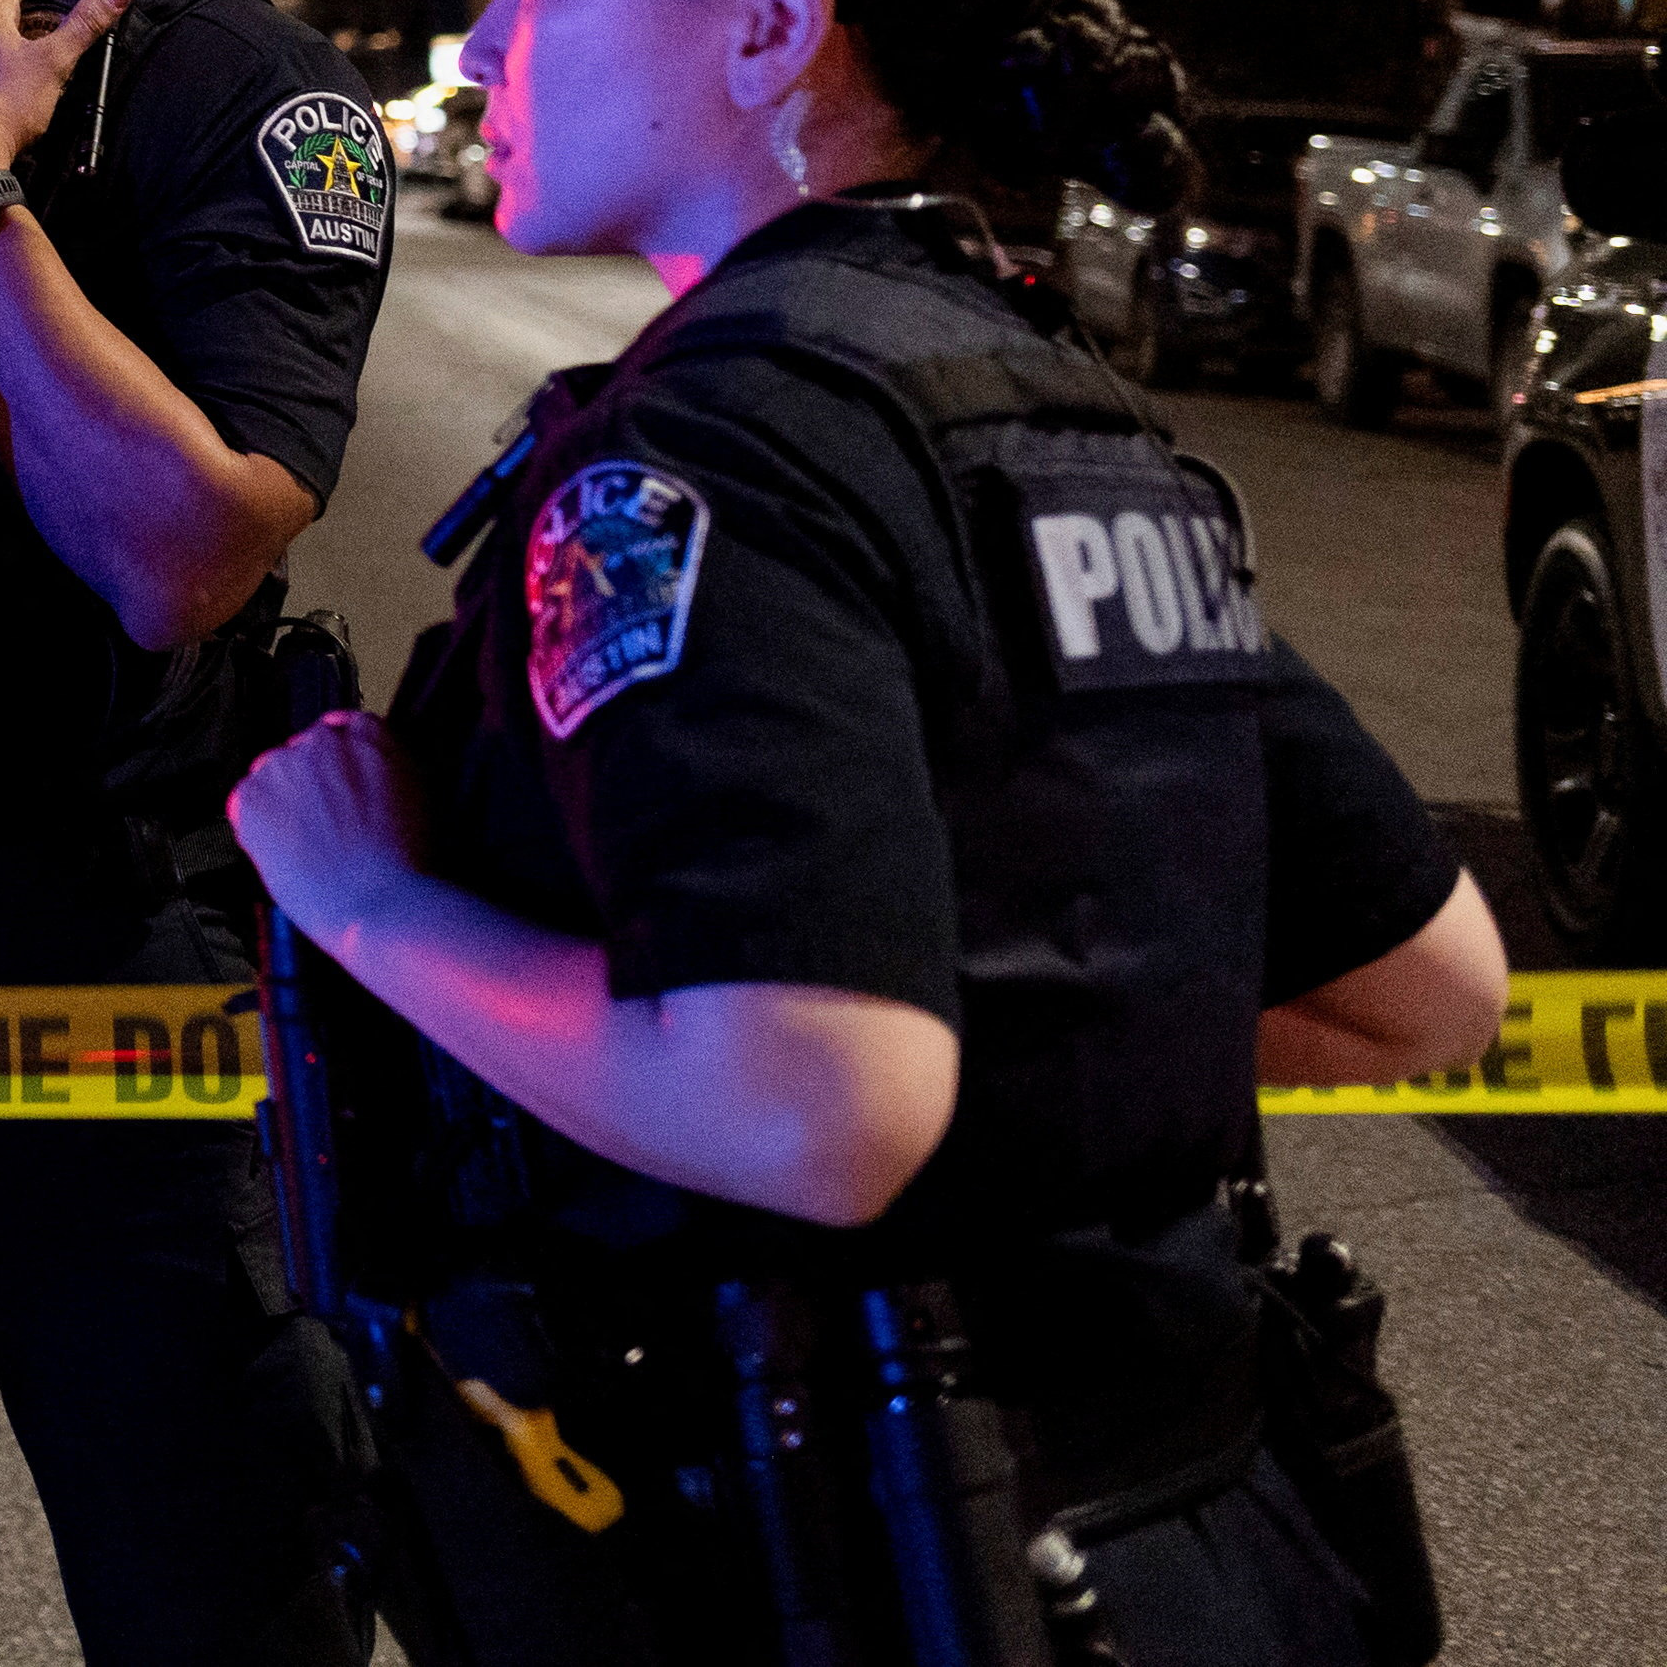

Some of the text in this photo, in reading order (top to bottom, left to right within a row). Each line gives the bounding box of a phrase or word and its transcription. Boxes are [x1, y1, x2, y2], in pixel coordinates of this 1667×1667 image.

[271, 101, 383, 171] POLICE
[284, 160, 322, 172] CAPITAL
[310, 218, 376, 252] AUSTIN
